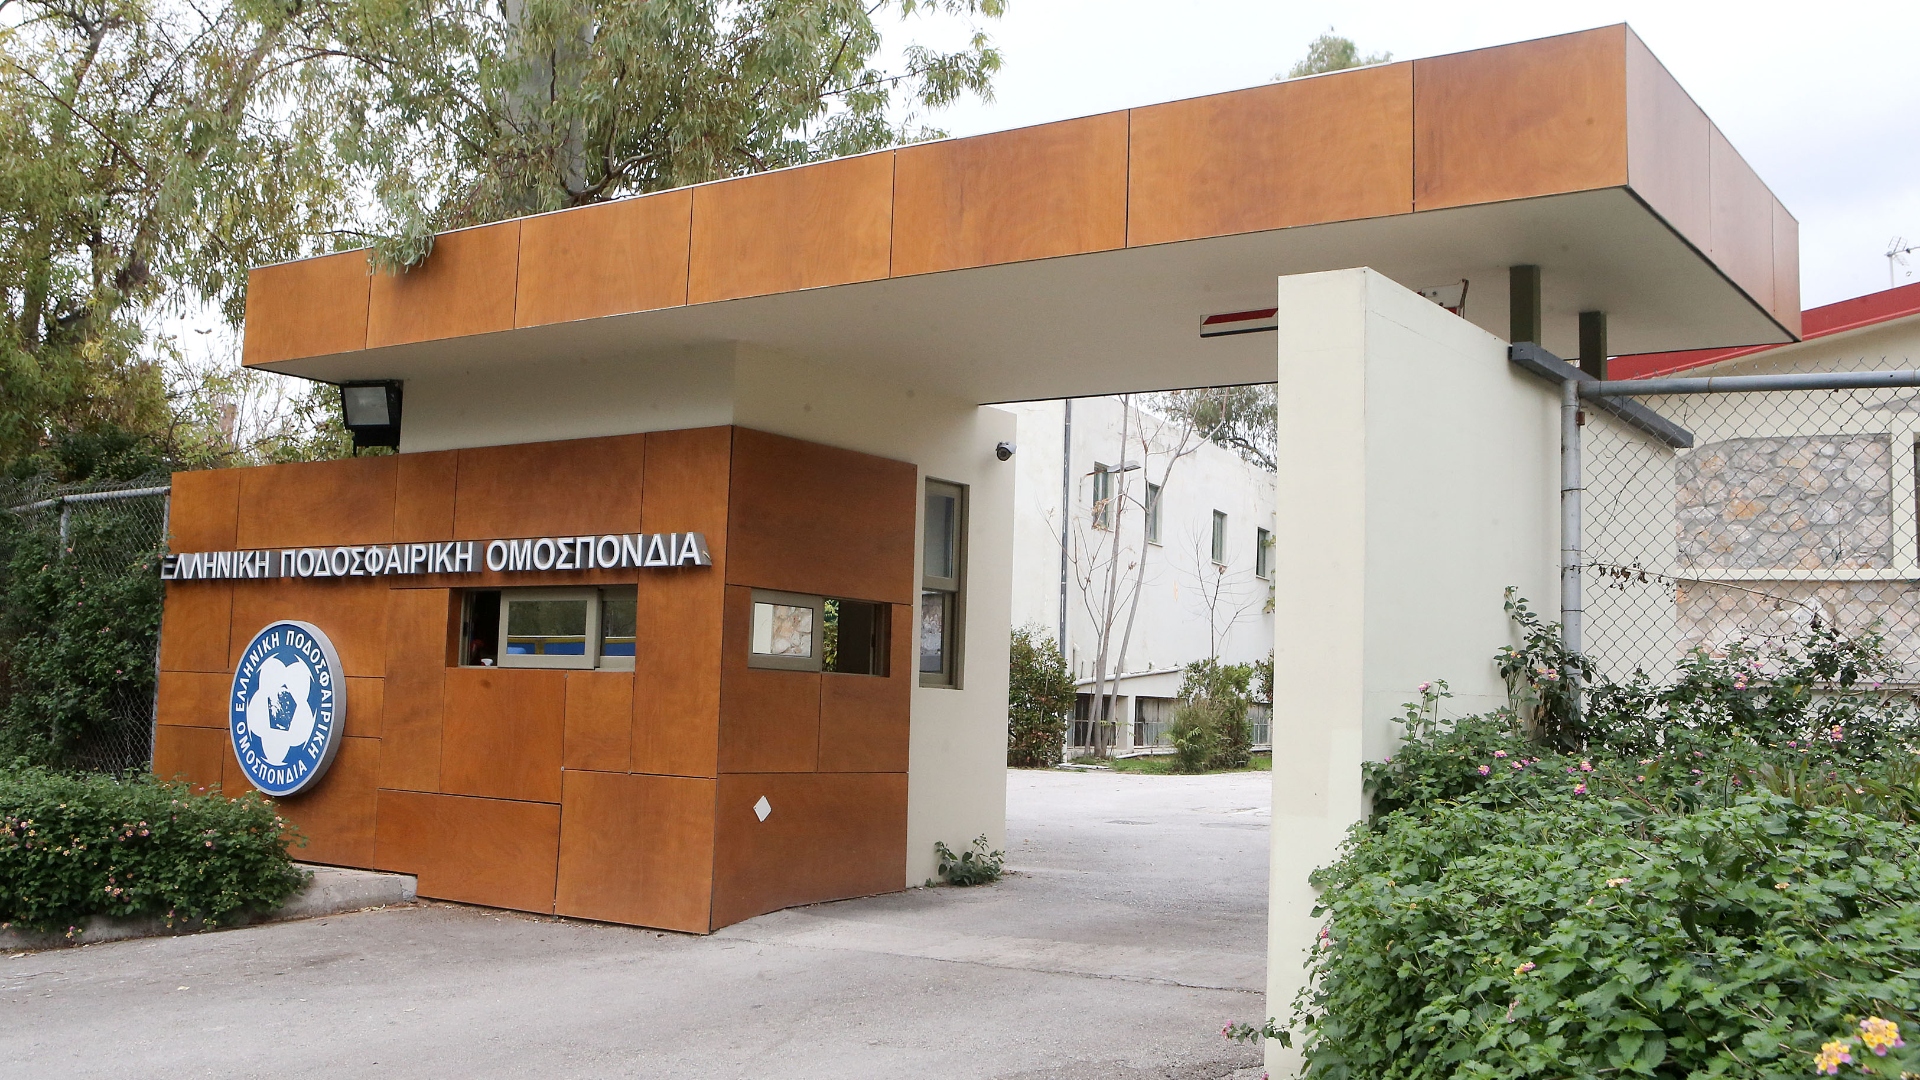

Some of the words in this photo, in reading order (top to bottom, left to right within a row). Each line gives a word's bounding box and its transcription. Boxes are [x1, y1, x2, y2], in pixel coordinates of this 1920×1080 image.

[161, 550, 271, 580] ΕΛΛΗΝΙΚΗ
[280, 541, 475, 578] ΠΟΔΟΣΦΑΙΡΙΚΗ
[486, 532, 704, 573] ΟΜΟΣΠΟΝΔΙΑ
[235, 631, 280, 712] ΕΛΛΗΝΙΚΗ
[285, 630, 333, 760] ΠΟΔΟΣΦΑΙΡΙΚΗ
[236, 721, 308, 785] ΟΜΟΣΠΟΝΔΙΑ
